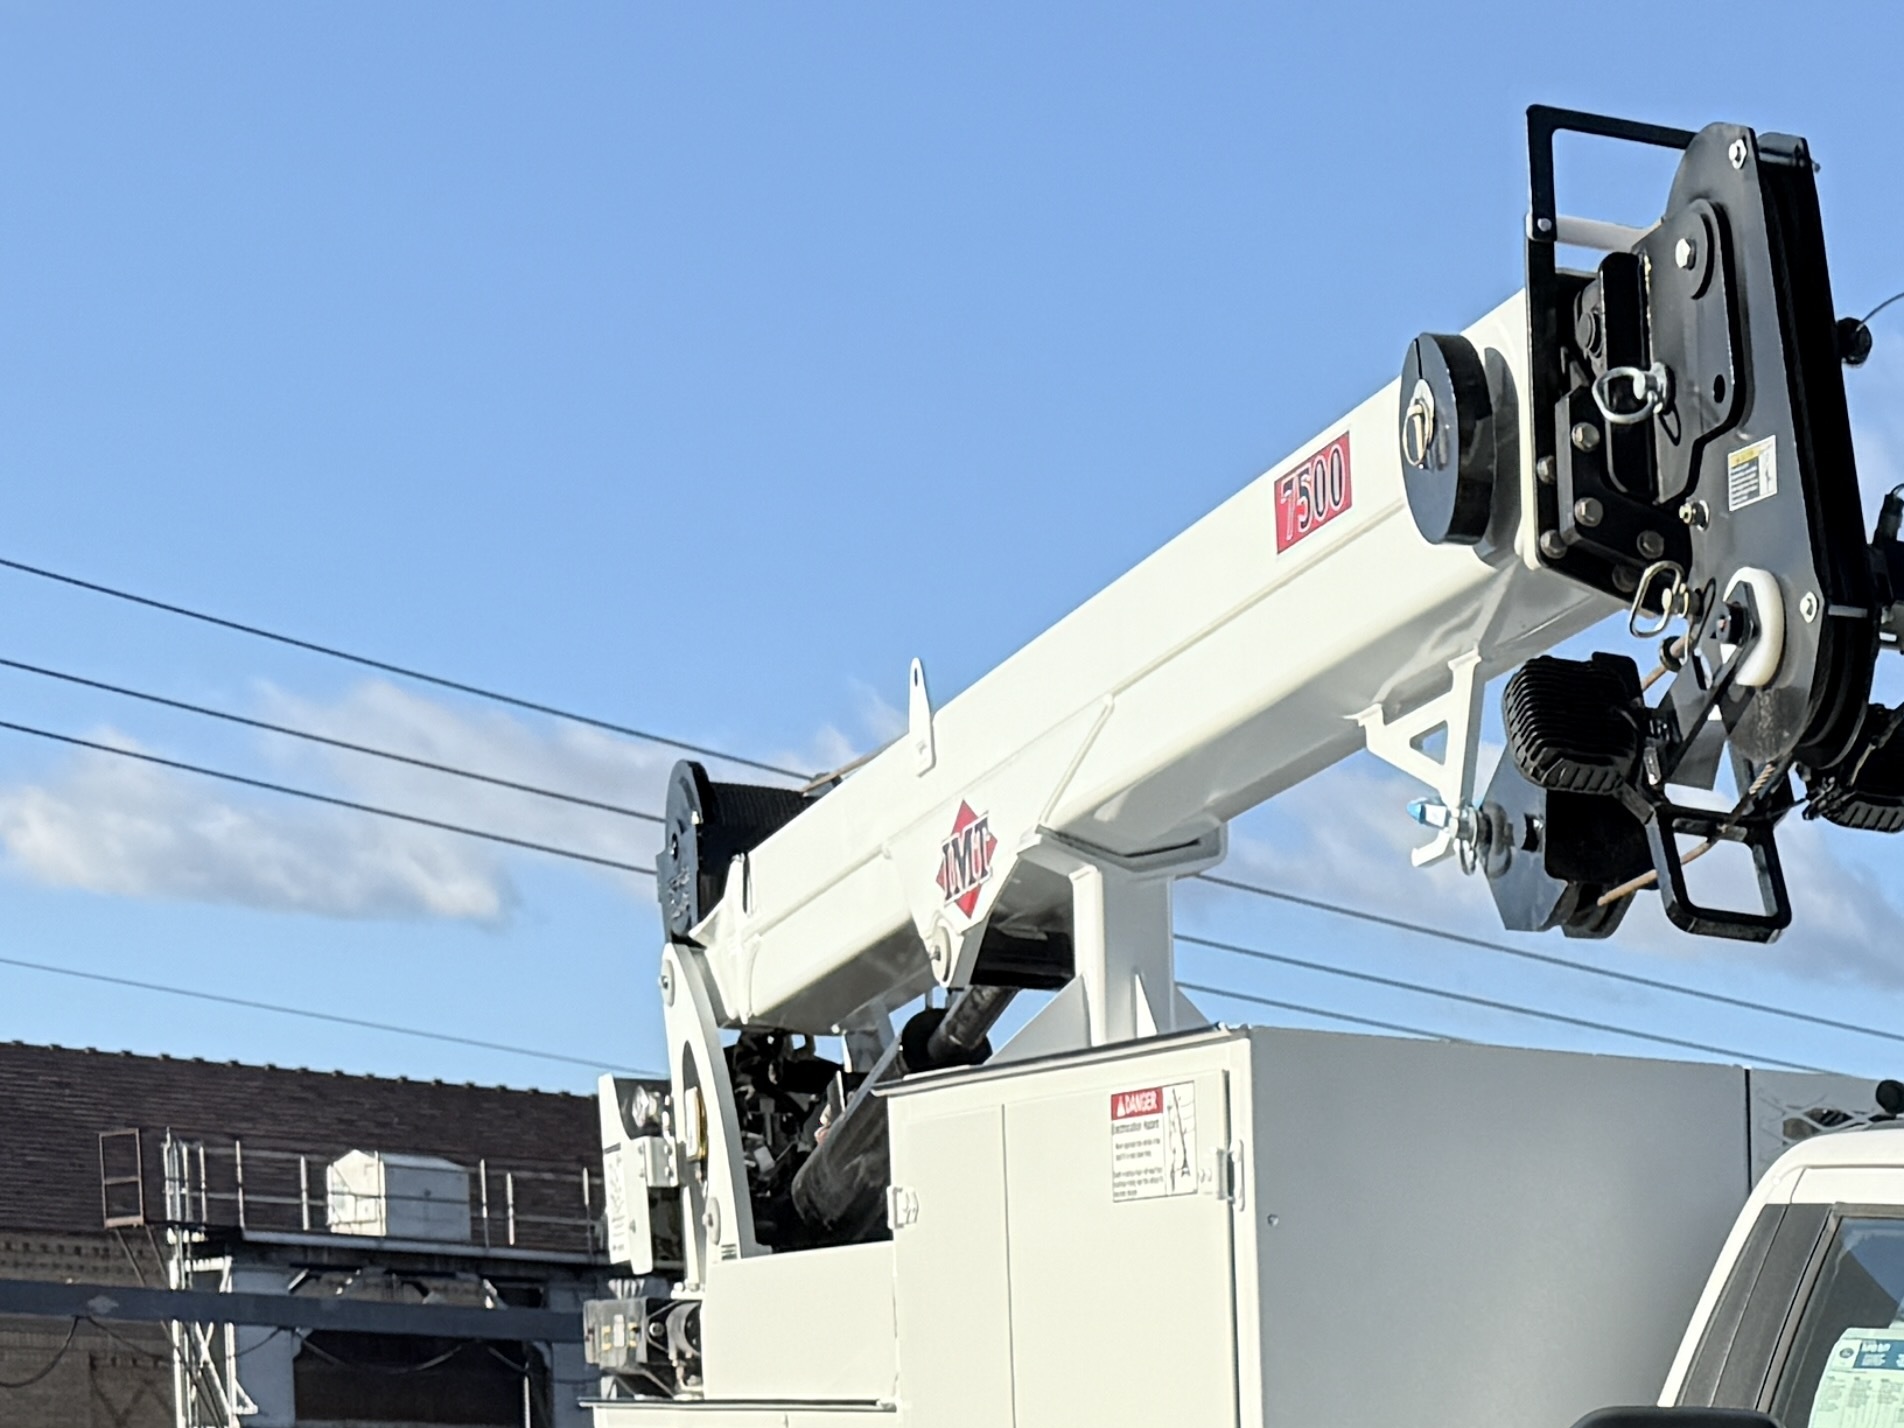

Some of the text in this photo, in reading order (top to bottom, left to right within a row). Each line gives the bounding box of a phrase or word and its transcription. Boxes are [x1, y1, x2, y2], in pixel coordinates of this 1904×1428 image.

[1281, 443, 1346, 541] 7500
[941, 811, 992, 907] IMT
[1124, 1090, 1157, 1114] DANGER
